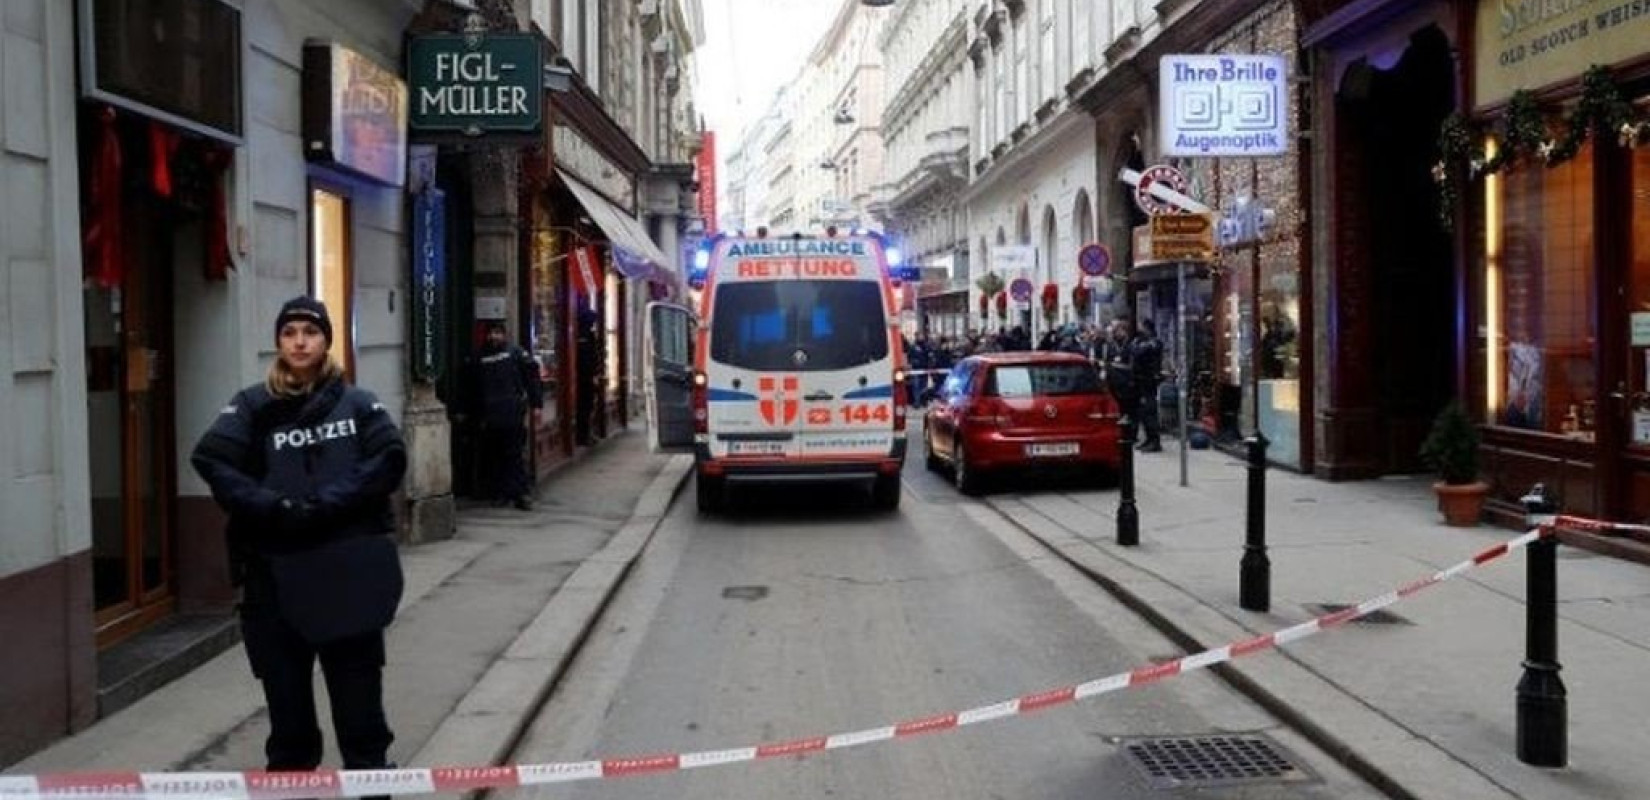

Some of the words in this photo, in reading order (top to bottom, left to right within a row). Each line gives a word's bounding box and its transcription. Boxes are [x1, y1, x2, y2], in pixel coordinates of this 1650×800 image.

[435, 53, 517, 82] FIGL-
[1173, 62, 1218, 81] Ihre
[1220, 58, 1277, 81] Brille
[420, 85, 529, 115] MÜLLER
[1175, 133, 1279, 152] Augenoptik
[728, 241, 865, 257] AMBULANCE
[737, 258, 858, 277] RETTUNG
[840, 403, 890, 424] 144
[273, 418, 357, 450] POLIZEI
